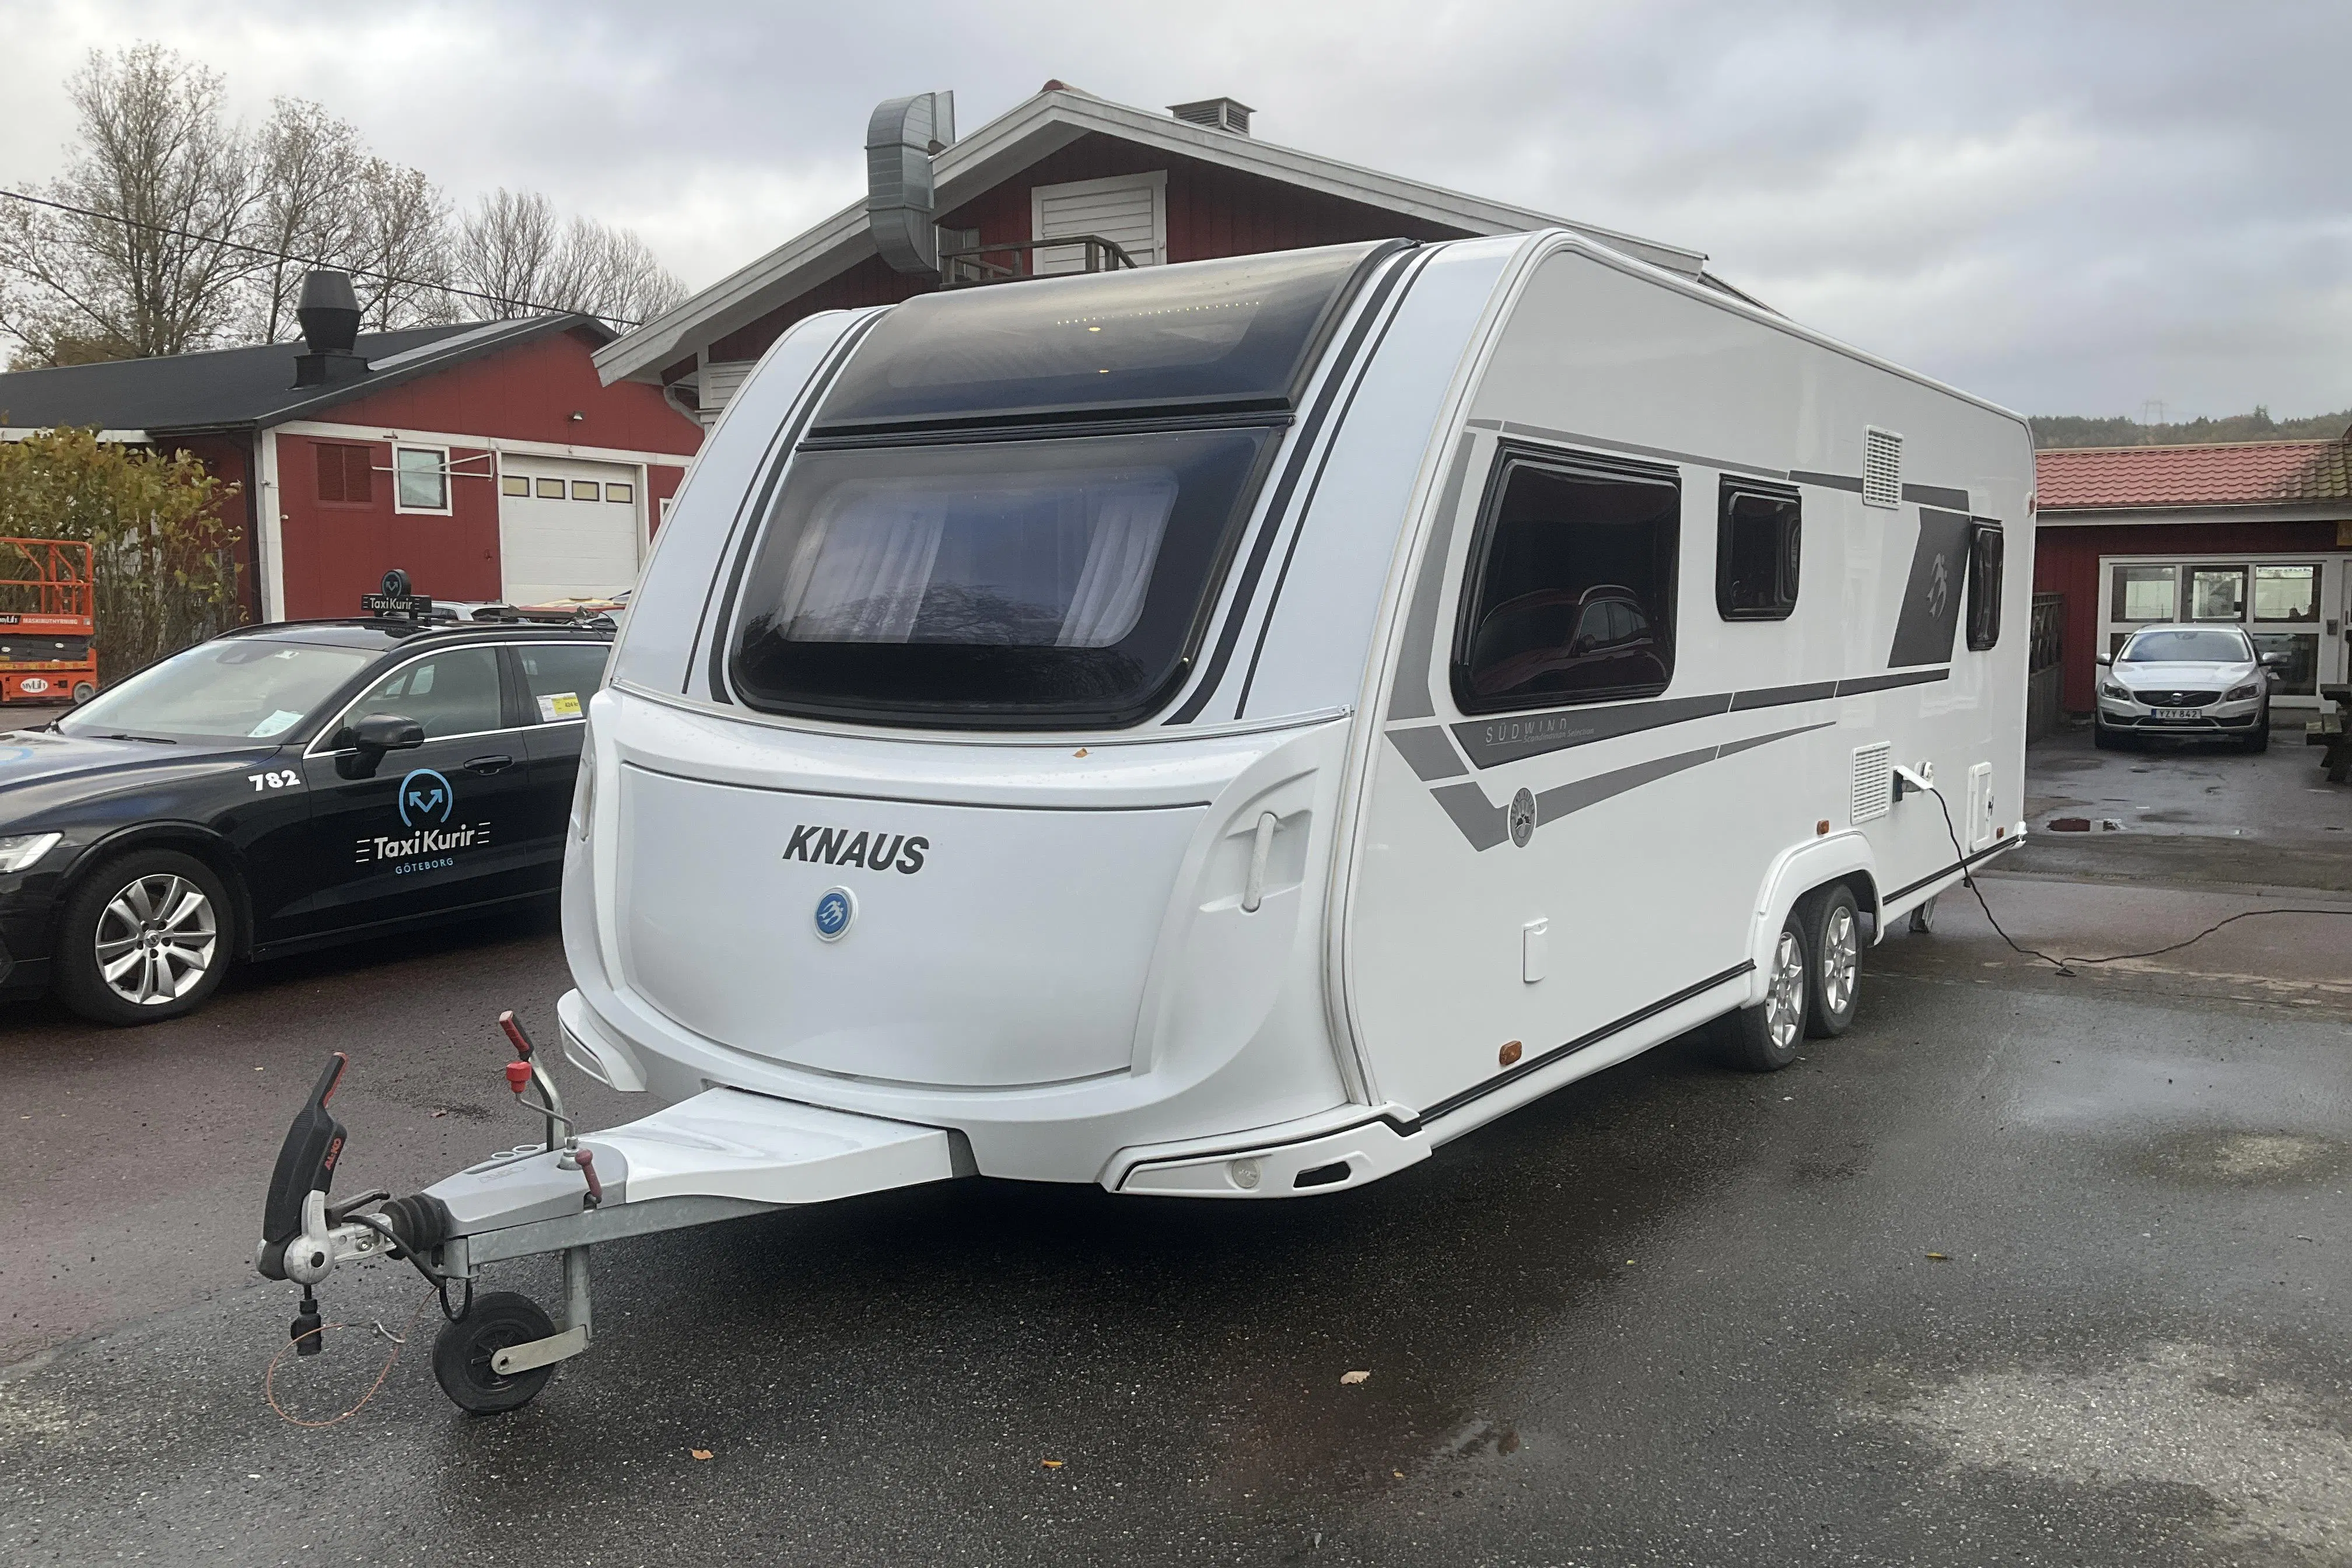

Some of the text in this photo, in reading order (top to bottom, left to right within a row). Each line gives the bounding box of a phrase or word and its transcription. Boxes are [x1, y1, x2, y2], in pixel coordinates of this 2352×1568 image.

[370, 597, 412, 610] TaxiKurir
[2160, 710, 2197, 718] YZY 842
[1567, 727, 1594, 738] Selection
[248, 770, 300, 791] 782
[374, 824, 475, 859] TaxiKurir
[782, 824, 929, 874] KNAUS
[395, 858, 453, 874] GÖTEBORG
